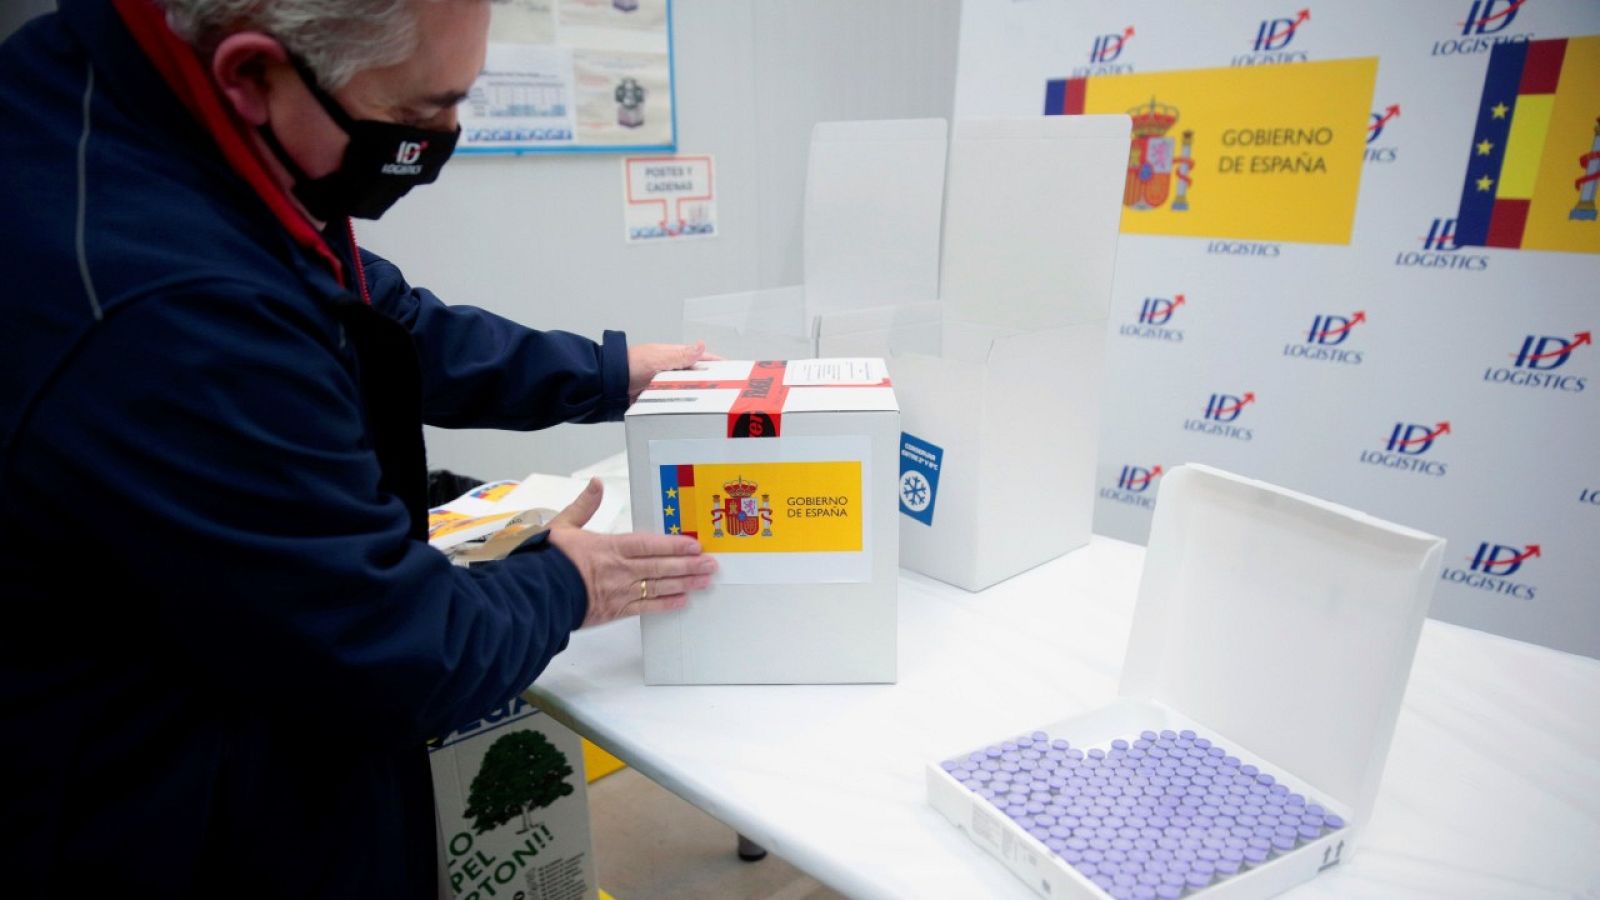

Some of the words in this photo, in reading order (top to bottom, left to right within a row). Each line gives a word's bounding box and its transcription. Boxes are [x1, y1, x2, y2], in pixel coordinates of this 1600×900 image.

[1253, 18, 1296, 51] ID
[1090, 34, 1123, 63] ID
[1221, 127, 1333, 147] GOBIERNO
[396, 141, 421, 164] ID
[1218, 156, 1245, 173] DE
[1250, 151, 1327, 173] ESPAÑA
[645, 165, 684, 177] POSTES
[687, 165, 695, 175] Y
[645, 181, 693, 193] CADENAS
[1207, 239, 1282, 257] LOGISTICS
[1396, 251, 1491, 272] LOGISTICS
[1138, 297, 1175, 326] ID
[1119, 324, 1185, 342] LOGISTICS
[1307, 313, 1351, 346] ID
[1283, 343, 1364, 365] LOGISTICS
[1513, 335, 1573, 371] ID
[1483, 367, 1588, 393] LOGISTICS
[1204, 392, 1243, 423] ID
[1184, 419, 1254, 441] LOGISTICS
[1386, 422, 1435, 456] ID
[1360, 450, 1448, 477] LOGISTICS
[1118, 465, 1150, 492] ID
[787, 496, 848, 506] GOBIERNO
[787, 509, 802, 518] DE
[805, 506, 848, 517] ESPAÑA
[1470, 542, 1523, 577] ID
[1441, 568, 1538, 601] LOGISTICS
